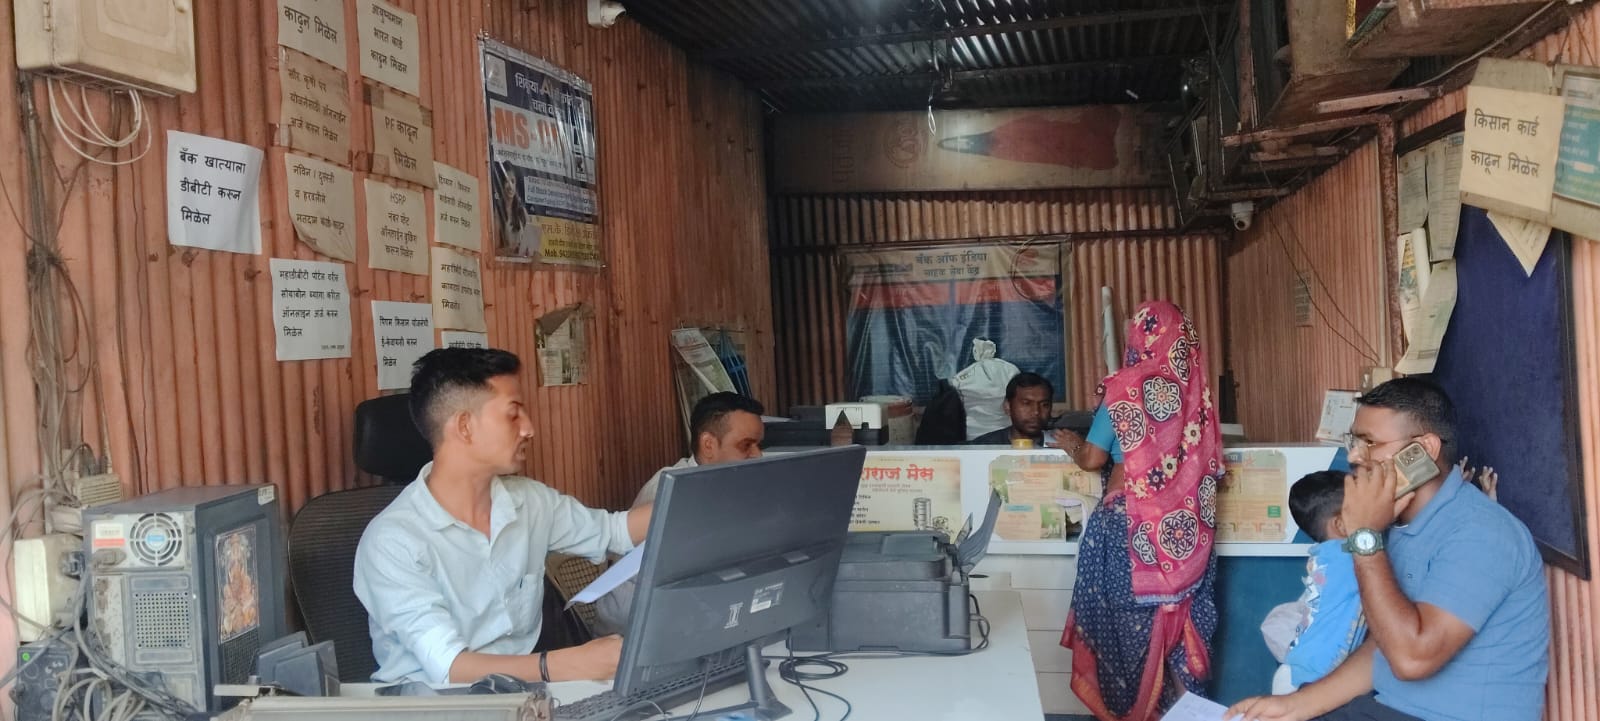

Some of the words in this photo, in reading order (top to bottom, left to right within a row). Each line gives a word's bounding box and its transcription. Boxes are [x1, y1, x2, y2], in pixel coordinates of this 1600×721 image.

[314, 16, 338, 44] मिळेल
[385, 116, 394, 130] PF
[1474, 108, 1510, 132] किसान
[1517, 115, 1540, 137] कार्ड
[204, 155, 247, 174] खात्याला
[393, 147, 417, 171] मिळेल
[1470, 150, 1502, 175] काढून
[1507, 152, 1540, 177] मिळेल
[179, 177, 212, 196] डीबीटी
[180, 206, 211, 224] मिळेल
[936, 251, 958, 264] ऑफ
[960, 250, 988, 264] इंडिया
[283, 325, 303, 336] मिळेल
[906, 463, 935, 481] मेस
